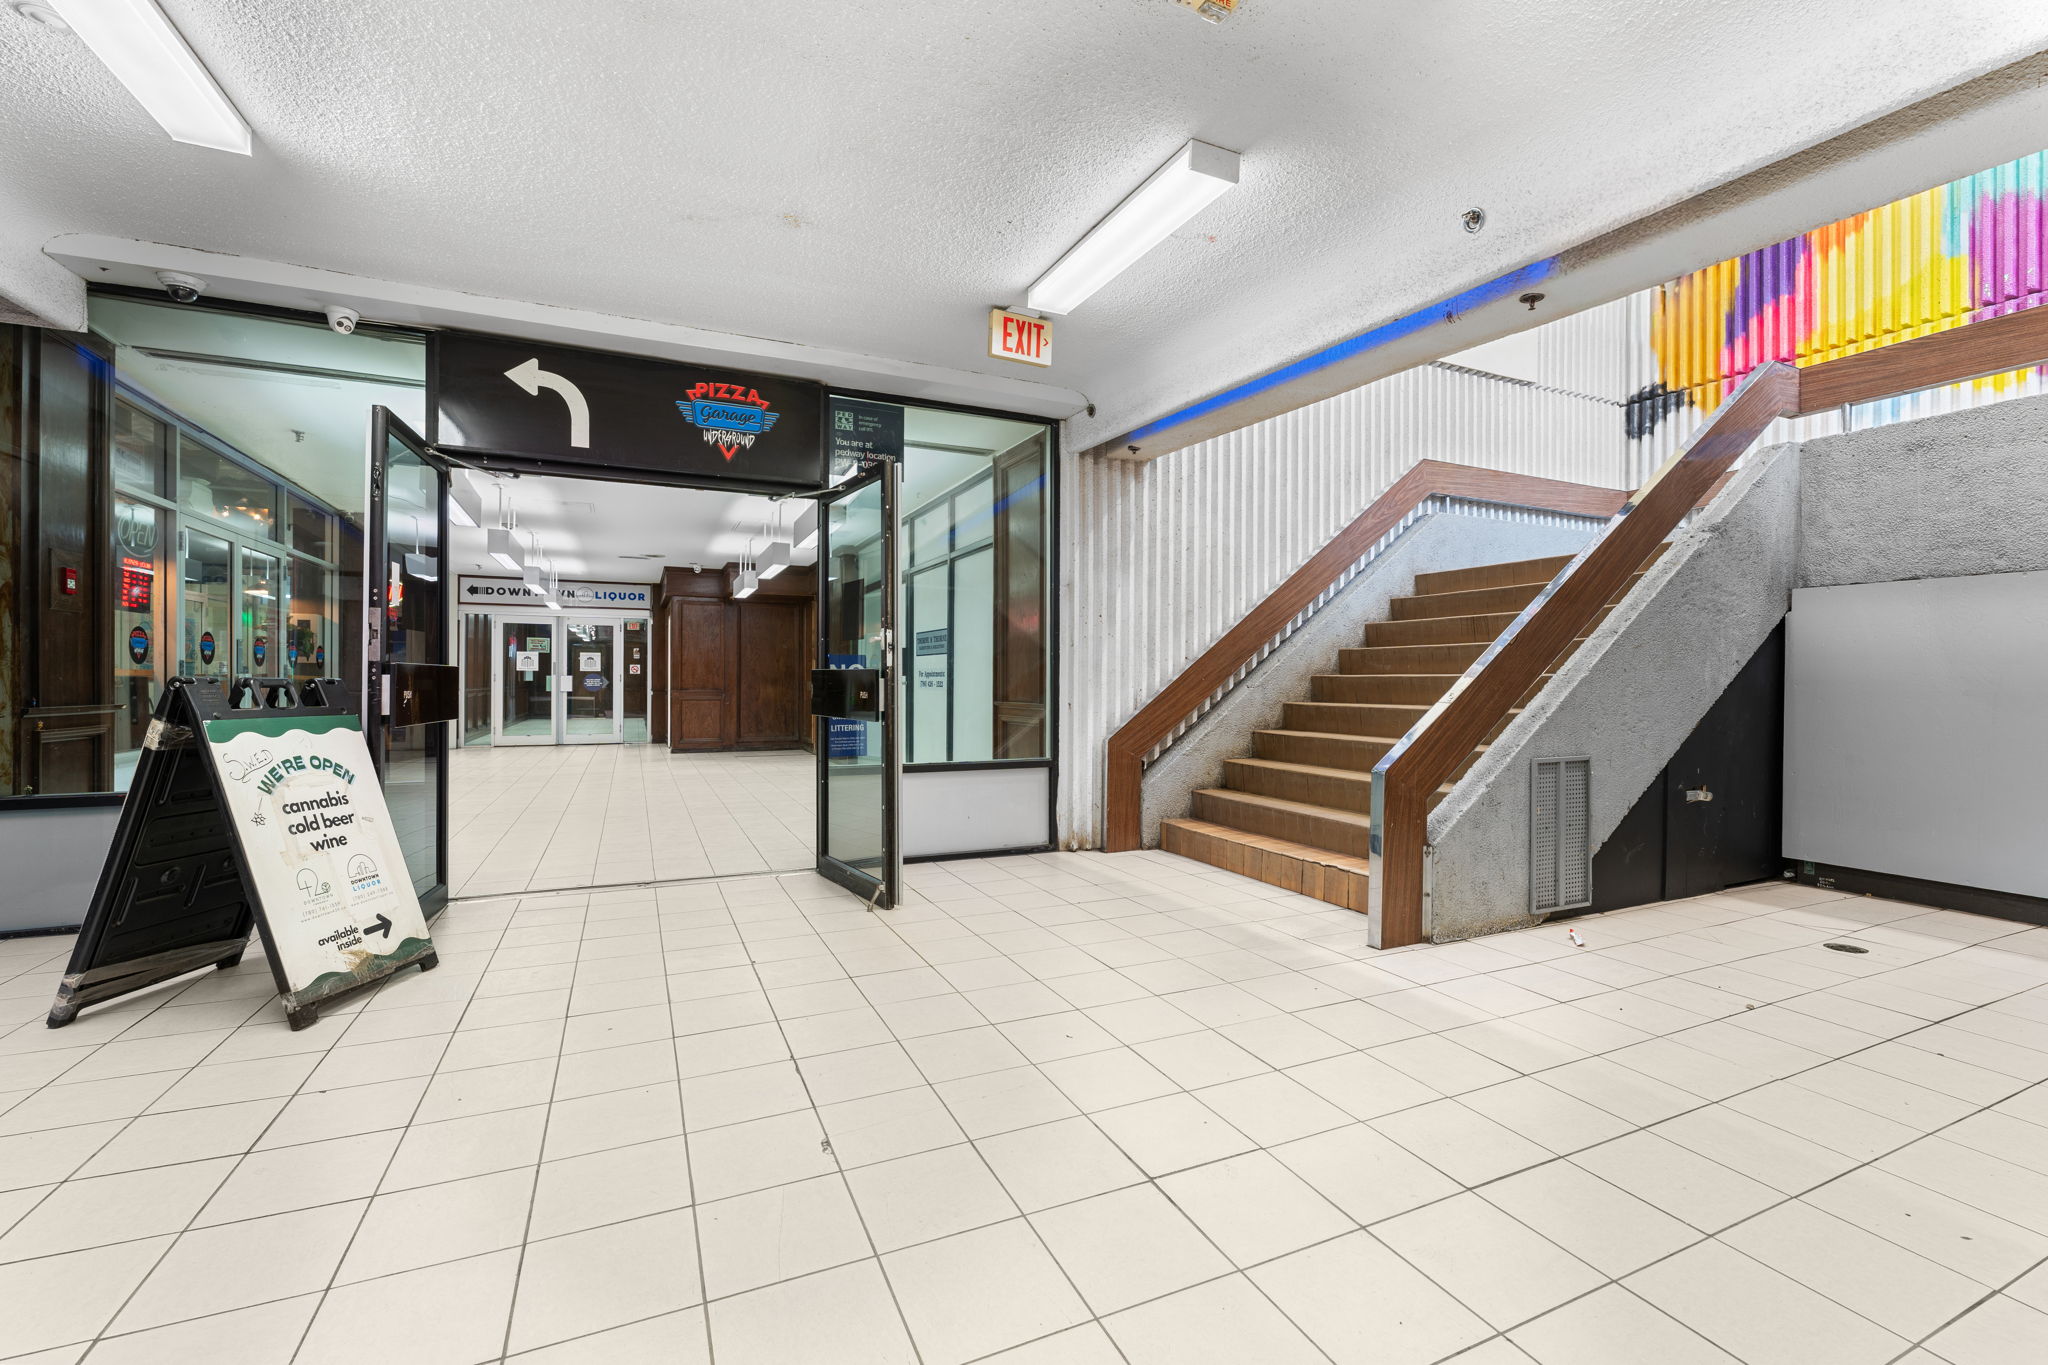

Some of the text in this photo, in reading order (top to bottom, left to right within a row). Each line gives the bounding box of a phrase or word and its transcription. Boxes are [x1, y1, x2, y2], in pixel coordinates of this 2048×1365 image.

[1003, 316, 1045, 358] EXIT
[688, 383, 768, 408] PIZZA
[701, 406, 761, 425] Garage
[703, 429, 755, 449] UNDERGROUND
[835, 437, 873, 449] You are at
[834, 449, 896, 462] pedway location
[121, 519, 155, 547] OPEN
[486, 586, 646, 601] DOWNN LIQUOR
[830, 723, 865, 733] LITTERING
[257, 755, 356, 795] WE'RE OPEN
[282, 790, 350, 815] cannabis
[288, 812, 355, 836] cold beer
[310, 833, 348, 852] wine
[351, 873, 380, 885] DOWNTOWN
[352, 879, 381, 892] LIQUOR
[318, 924, 359, 947] available
[336, 935, 363, 951] inside
